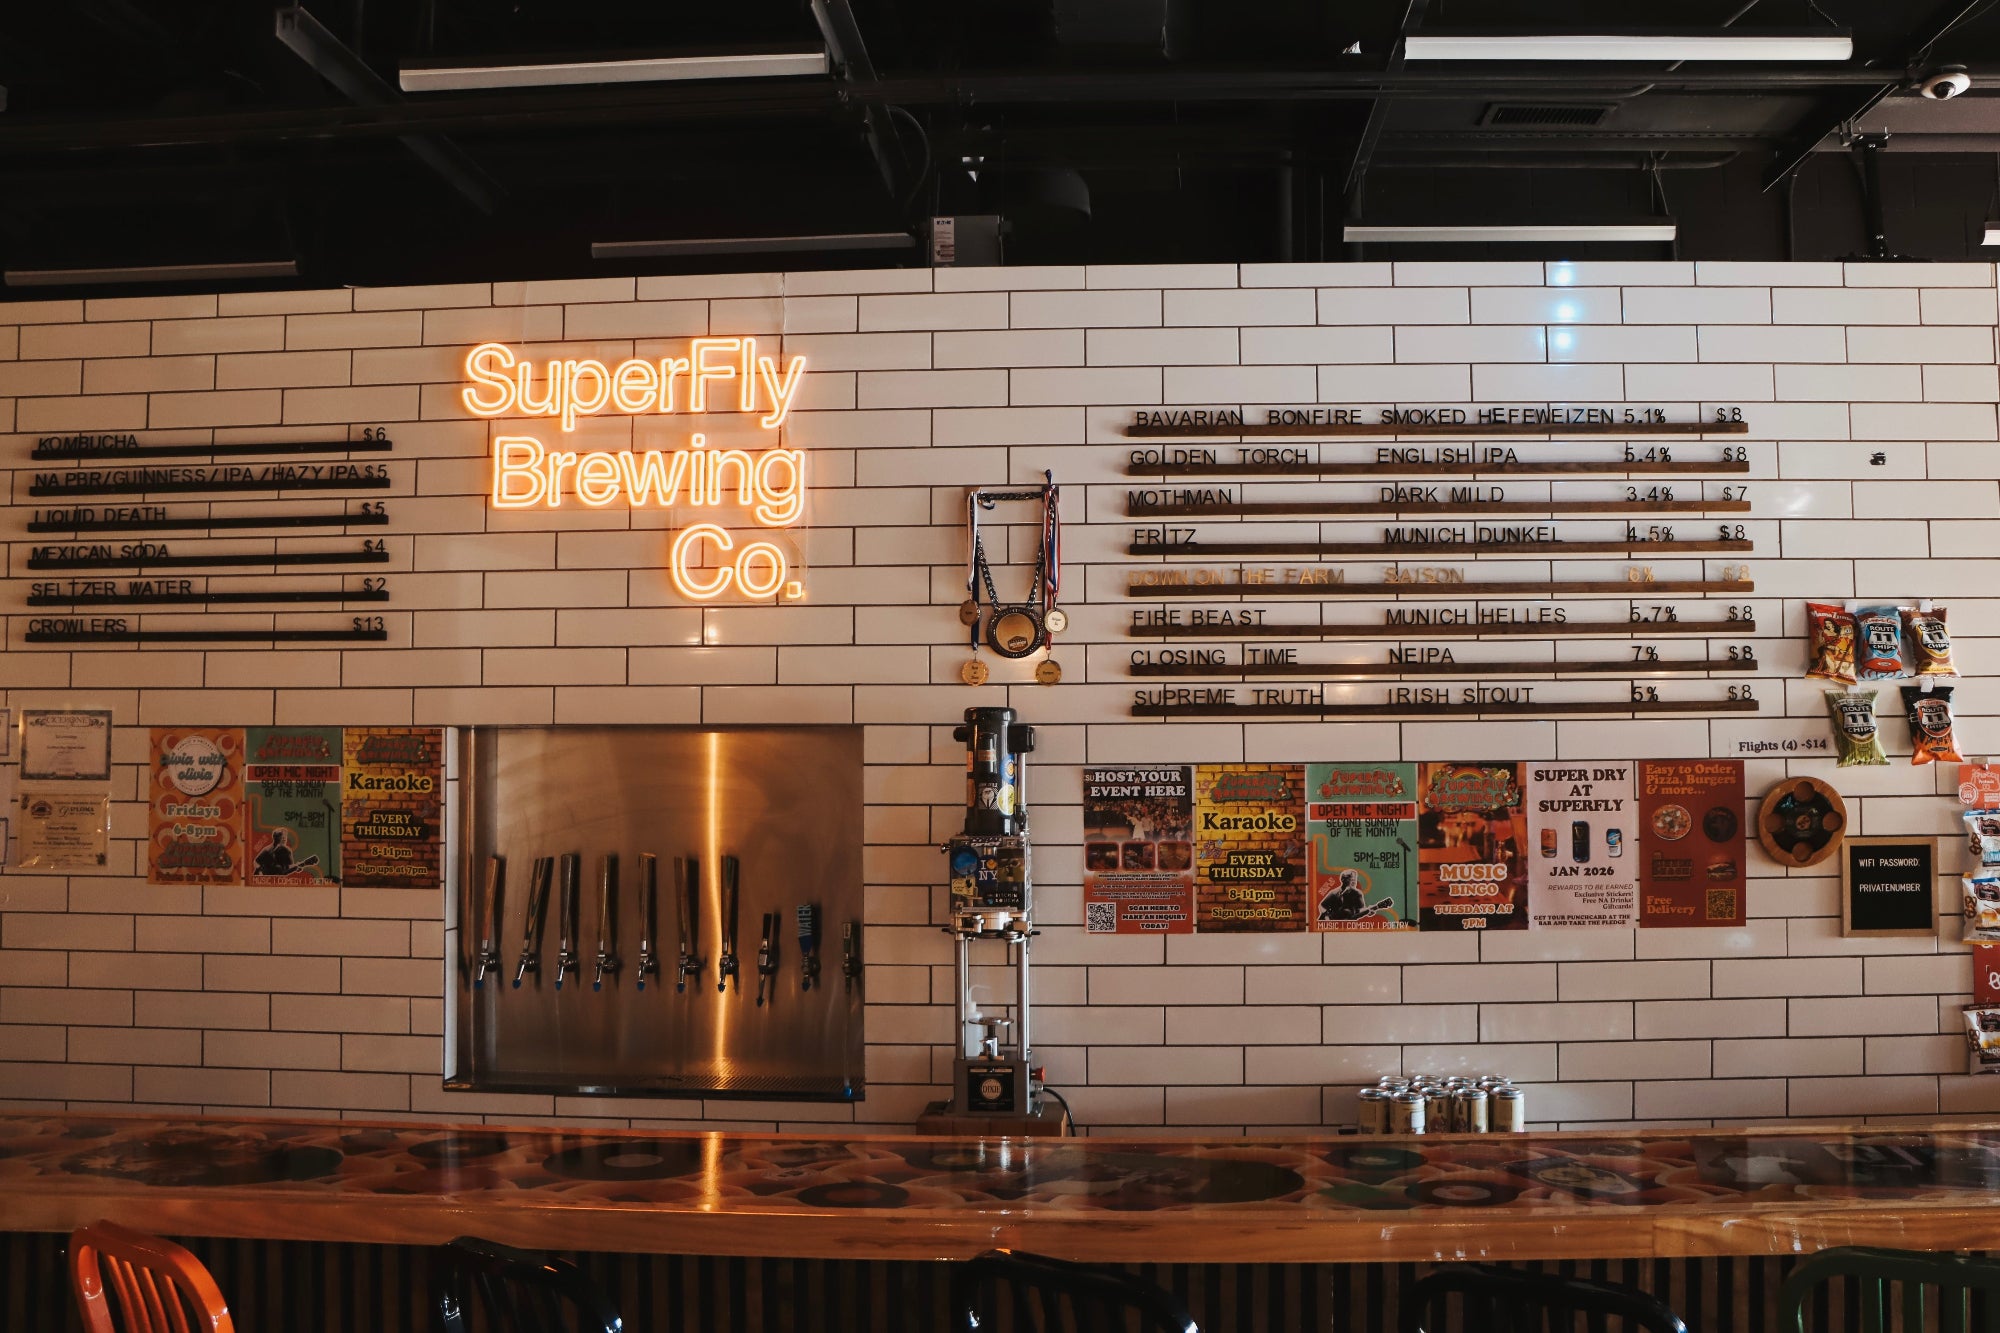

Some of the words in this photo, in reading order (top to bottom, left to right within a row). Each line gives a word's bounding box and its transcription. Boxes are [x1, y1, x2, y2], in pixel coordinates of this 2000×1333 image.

[462, 338, 806, 432] SuperFly
[1136, 409, 1243, 426] BAVARIAN
[1268, 409, 1362, 425] BONFIRE
[1381, 409, 1466, 425] SMOKED
[1478, 407, 1614, 424] HEFEWEIZEN
[1624, 408, 1666, 424] 5.1%
[1717, 407, 1743, 423] $8
[38, 434, 139, 451] KOMBUCHA
[363, 427, 386, 442] $6
[1130, 449, 1216, 465] GOLDEN
[1238, 448, 1308, 464] TORCH
[1377, 448, 1469, 464] ENGLISH
[1484, 447, 1518, 463] IPA
[1625, 447, 1672, 463] 5.4%
[1723, 447, 1747, 462] $8
[35, 473, 59, 487] NA
[330, 465, 358, 480] IPA
[365, 464, 387, 479] $5
[492, 433, 805, 526] Brewing
[1128, 488, 1232, 506] MOTHMAN
[1381, 487, 1438, 503] DARK
[1451, 487, 1504, 503] MILD
[1626, 486, 1674, 502] 3.4%
[1722, 486, 1747, 501] $7
[34, 509, 95, 524] LIQUID
[104, 507, 166, 522] DEATH
[362, 502, 385, 516] $5
[1134, 528, 1197, 544] FRITZ
[1385, 527, 1465, 543] MUNICH
[1478, 526, 1562, 542] DUNKEL
[1627, 525, 1674, 542] 4.5%
[1720, 524, 1745, 541] $8
[32, 545, 112, 561] MEXICAN
[121, 544, 169, 559] SODA
[364, 539, 385, 554] $4
[671, 523, 802, 599] Co.
[1128, 568, 1190, 585] DOWN
[1195, 568, 1225, 585] ON
[1233, 568, 1274, 585] THE
[1284, 567, 1344, 584] FARM
[1384, 567, 1465, 583] SAISON
[31, 581, 116, 598] SELTZER
[129, 580, 191, 596] WATER
[364, 577, 385, 592] $2
[1133, 609, 1181, 626] FIRE
[1192, 609, 1266, 626] BEAST
[1386, 608, 1467, 625] MUNICH
[1481, 607, 1566, 624] HELLES
[1630, 605, 1678, 622] 5.7%
[1728, 605, 1753, 622] $8
[29, 619, 127, 634] CROWLERS
[353, 616, 384, 632] $13
[1131, 649, 1226, 665] CLOSING
[1248, 648, 1297, 665] TIME
[1389, 647, 1455, 664] NEIPA
[1631, 645, 1658, 662] 7%
[1728, 645, 1753, 661] $8
[1134, 688, 1236, 706] SUPREME
[1252, 688, 1324, 705] TRUTH
[1388, 687, 1449, 704] IRISH
[1463, 687, 1534, 704] STOUT
[1632, 685, 1658, 702] 5%
[1728, 684, 1752, 701] $8
[1850, 713, 1869, 723] 11
[1739, 741, 1779, 753] Flights
[1781, 740, 1798, 751] (4)
[1801, 739, 1827, 749] -$14
[255, 766, 280, 777] OPEN
[284, 766, 301, 777] MIC
[306, 766, 333, 777] NIGHT
[1534, 769, 1589, 781] SUPER
[1593, 769, 1627, 781] DRY
[1646, 764, 1675, 776] Easy
[1679, 765, 1691, 774] to
[1694, 764, 1736, 775] Order,
[350, 773, 431, 790] Karaoke
[1095, 771, 1135, 782] HOST
[1139, 771, 1181, 782] YOUR
[1646, 774, 1682, 786] Pizza,
[1686, 775, 1736, 786] Burgers
[1091, 786, 1141, 796] EVENT
[1145, 786, 1185, 796] HERE
[1569, 785, 1593, 796] AT
[1646, 785, 1658, 794] &
[167, 804, 220, 817] Fridays
[1318, 804, 1347, 816] OPEN
[1352, 804, 1370, 816] MIC
[1377, 804, 1408, 816] NIGHT
[1539, 800, 1624, 812] SUPERFLY
[373, 814, 411, 823] EVERY
[1203, 813, 1294, 830] Karaoke
[1327, 819, 1360, 827] SECOND
[1365, 818, 1400, 827] SUNDAY
[173, 824, 217, 837] 6-8pm
[357, 826, 421, 836] THURSDAY
[1331, 828, 1341, 837] OF
[1346, 828, 1361, 837] THE
[1366, 828, 1396, 837] MONTH
[372, 847, 412, 857] 8-11pm
[1354, 852, 1399, 862] 5PM-8PM
[1230, 855, 1273, 864] EVERY
[1858, 858, 1875, 867] WIFI
[979, 871, 997, 880] NY
[1212, 868, 1284, 878] THURSDAY
[1441, 865, 1506, 880] MUSIC
[1550, 866, 1579, 876] JAN
[1584, 866, 1614, 876] 2026
[1450, 884, 1498, 895] BINGO
[1859, 884, 1920, 892] PRIVATENUMBER
[1229, 889, 1274, 901] 8-11pm
[1647, 896, 1672, 905] Free
[1212, 908, 1234, 917] Sign
[1256, 909, 1266, 917] at
[1269, 909, 1291, 917] 7pm
[1435, 905, 1495, 914] TUESDAYS
[1497, 904, 1514, 913] AT
[1647, 905, 1696, 915] Delivery
[797, 904, 812, 938] WATER
[1462, 918, 1486, 928] 7PM
